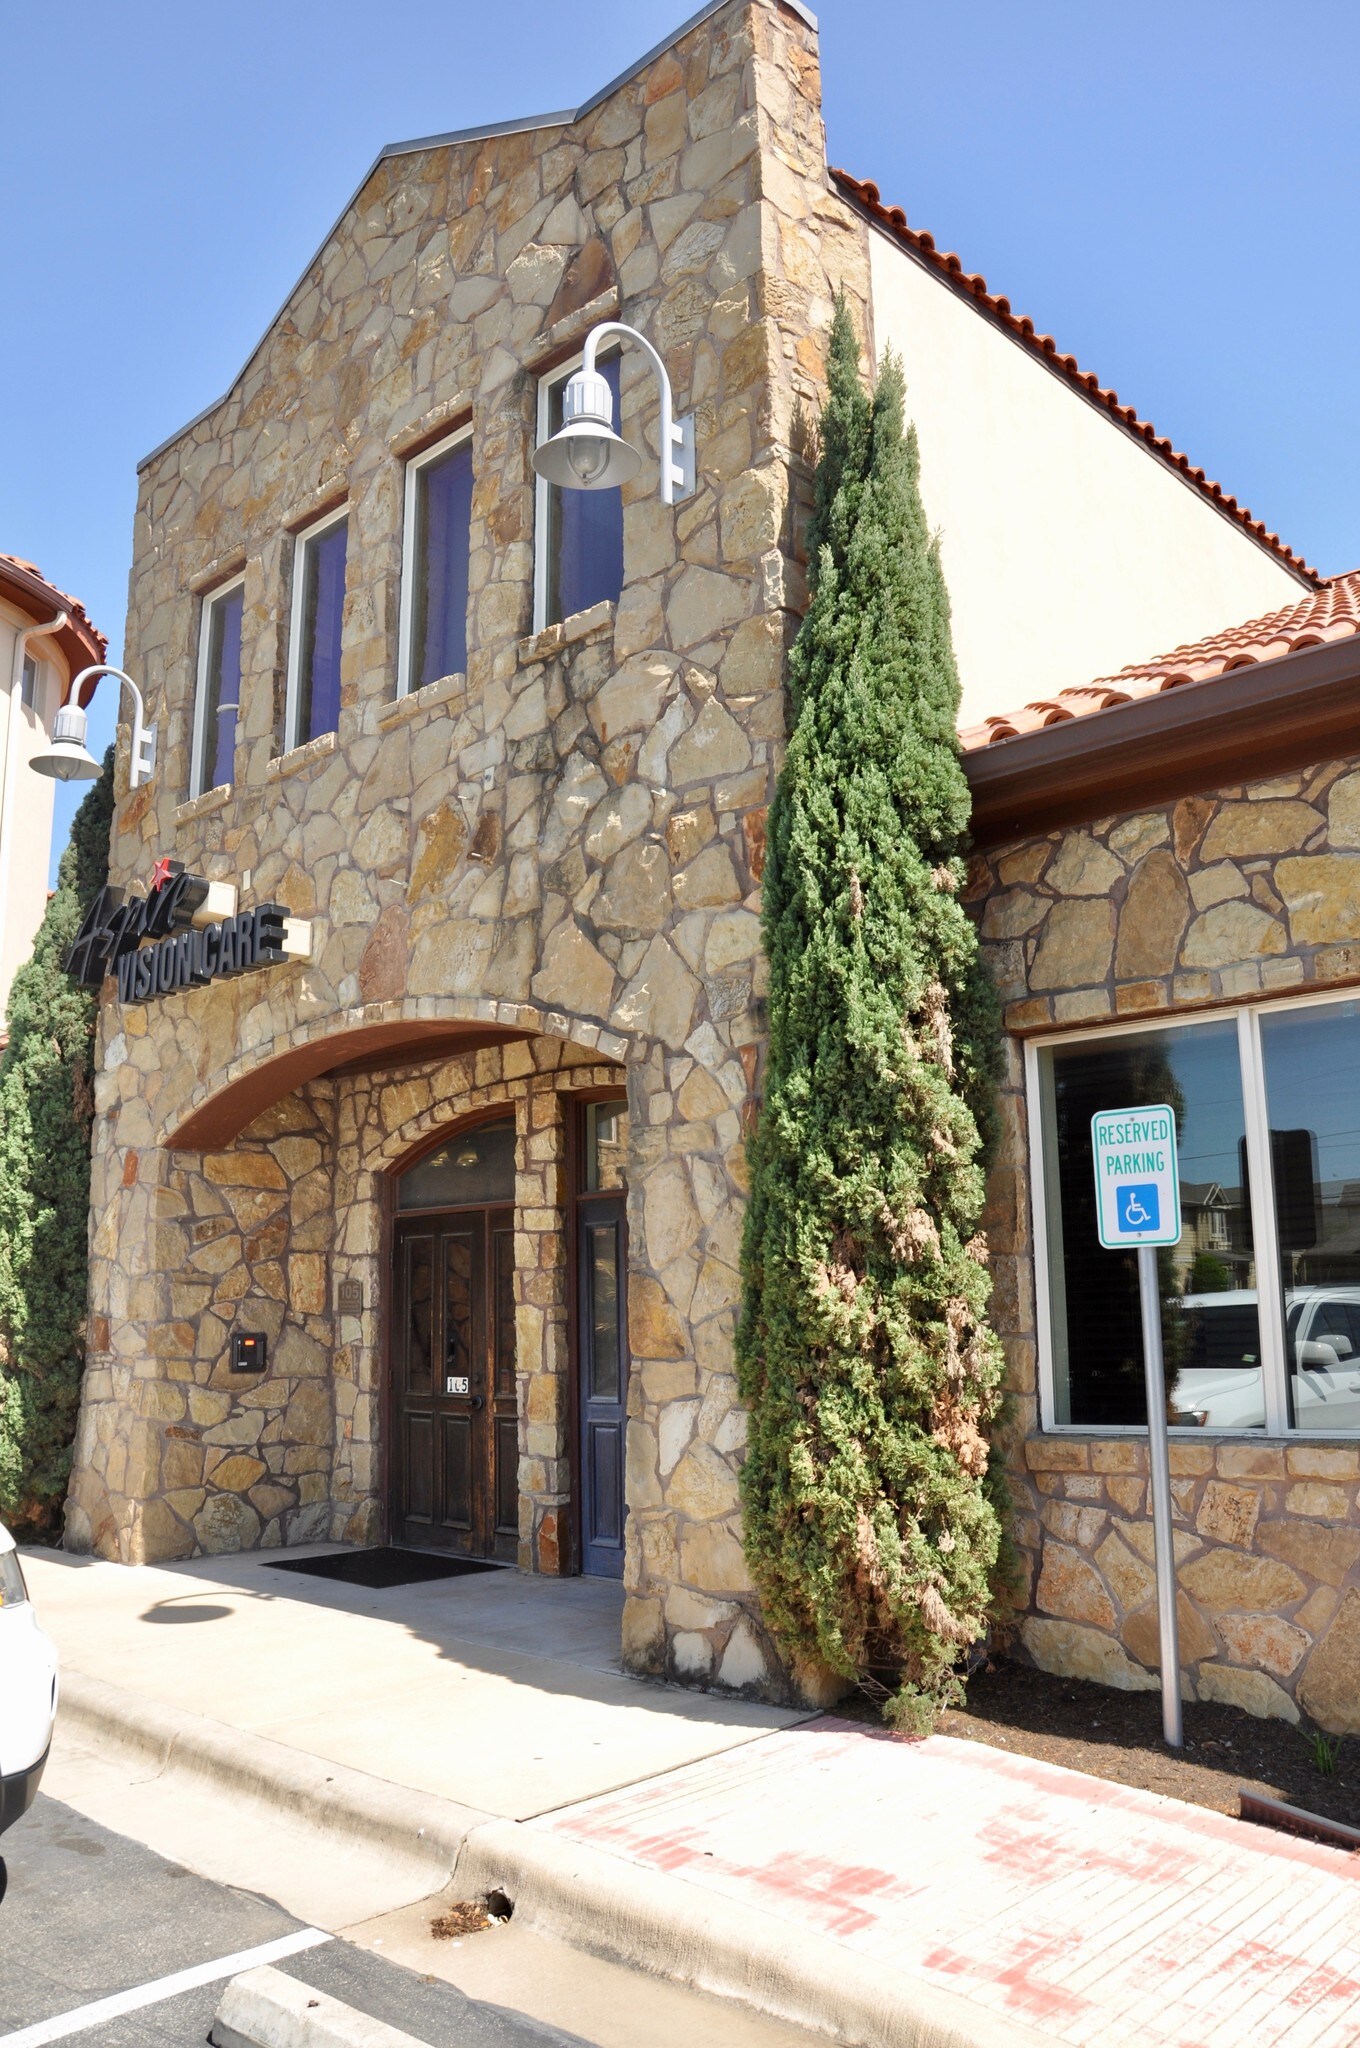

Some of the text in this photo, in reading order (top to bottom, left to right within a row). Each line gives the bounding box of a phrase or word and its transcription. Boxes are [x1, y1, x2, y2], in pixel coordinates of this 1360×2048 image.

[117, 903, 289, 1005] VISION CARE
[1099, 1119, 1168, 1146] RESERVED
[1106, 1151, 1165, 1176] PARKING
[340, 1285, 359, 1299] 105
